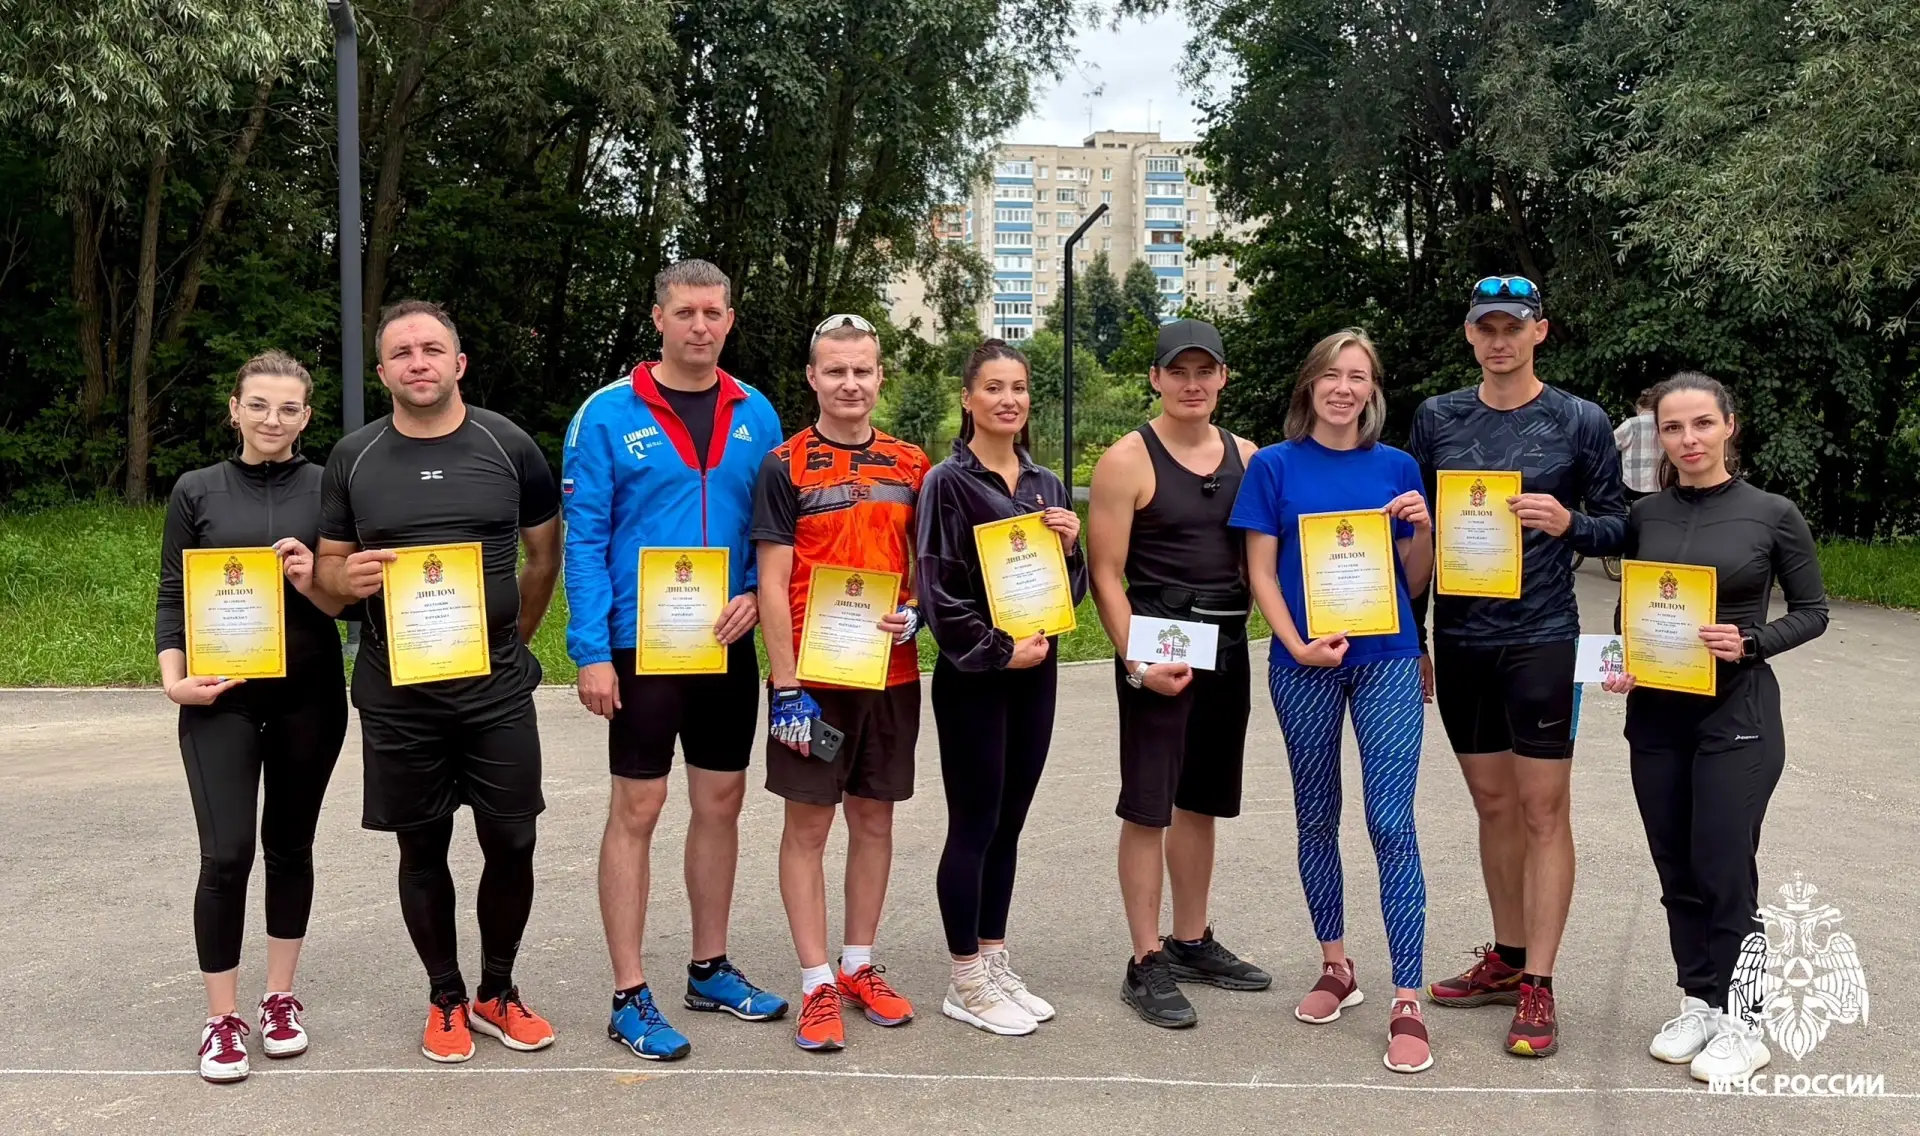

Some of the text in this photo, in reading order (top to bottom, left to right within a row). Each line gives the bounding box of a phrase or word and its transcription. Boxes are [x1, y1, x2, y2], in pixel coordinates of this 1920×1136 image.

[623, 425, 659, 443] LUKOIL
[1005, 551, 1038, 564] ДИПЛОМ
[1329, 551, 1366, 560] ДИПЛОМ
[215, 588, 254, 597] ДИПЛОМ
[415, 588, 456, 599] ДИПЛОМ
[834, 599, 871, 610] ДИПЛОМ
[1648, 601, 1686, 611] ДИПЛОМ
